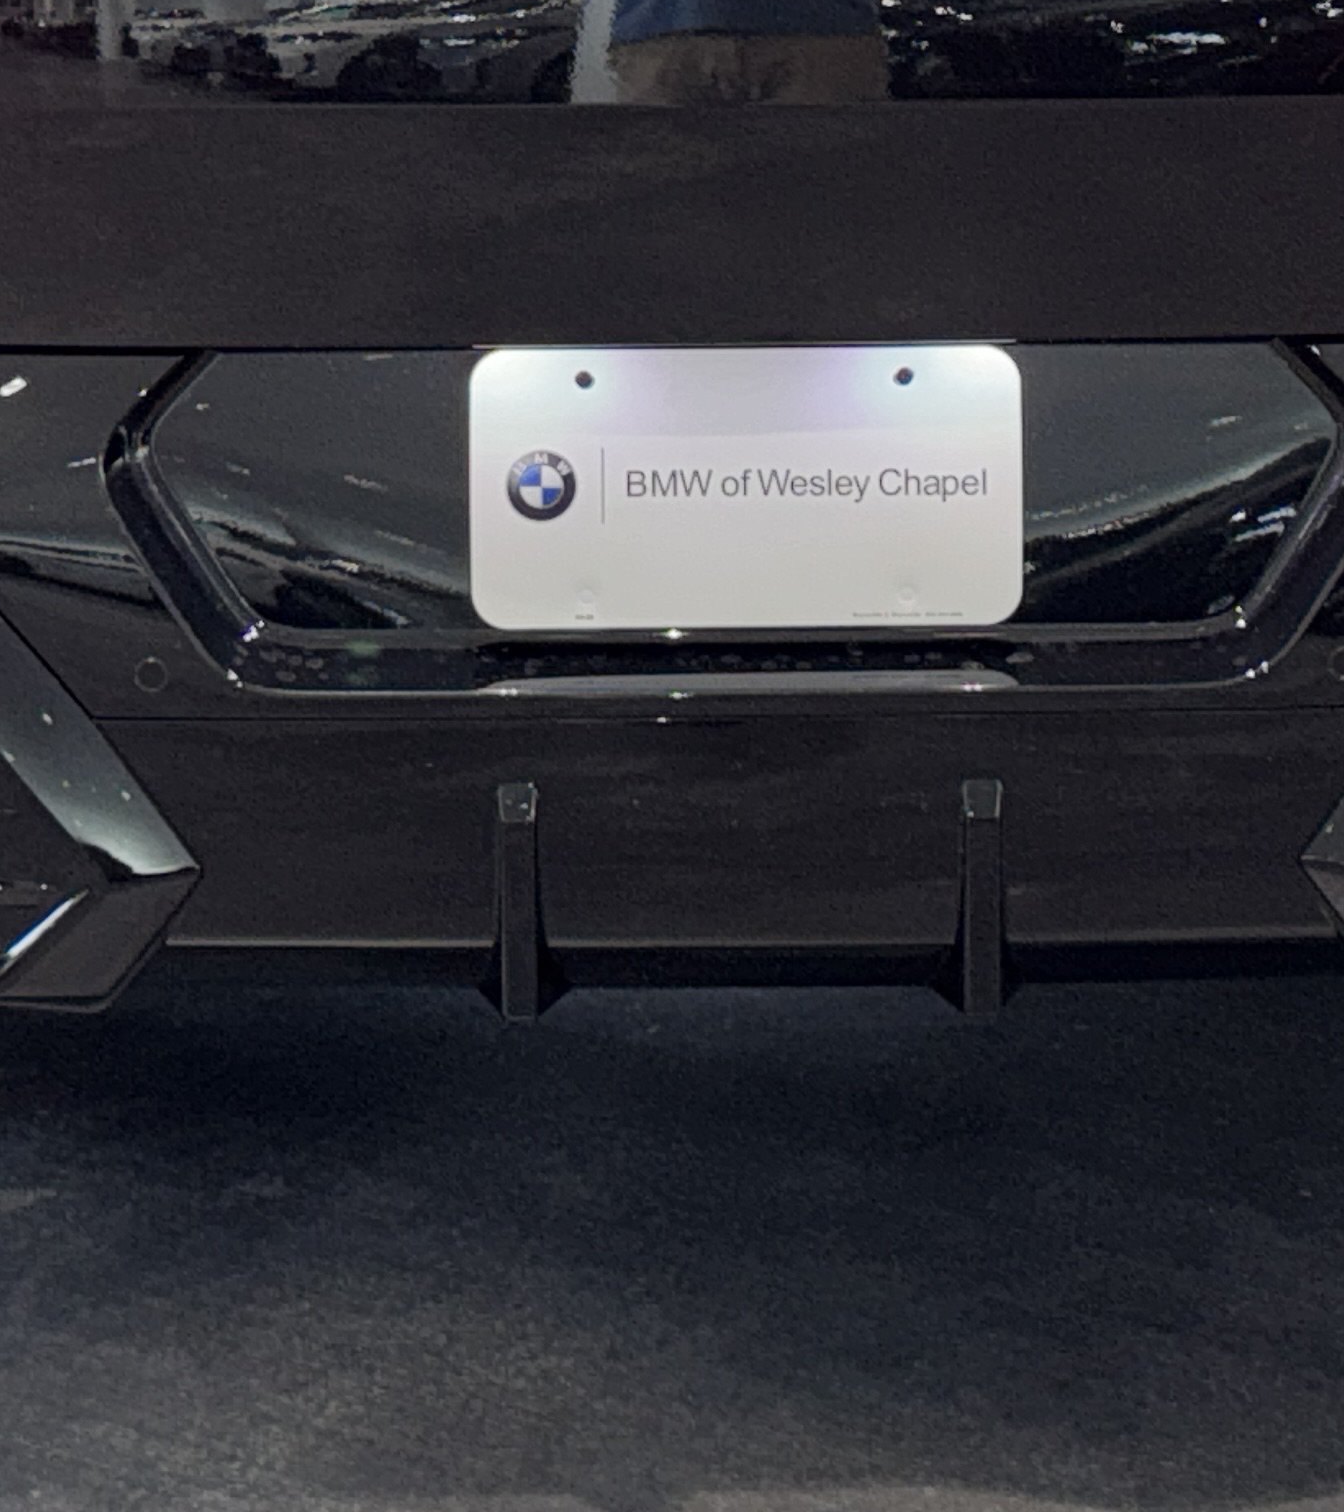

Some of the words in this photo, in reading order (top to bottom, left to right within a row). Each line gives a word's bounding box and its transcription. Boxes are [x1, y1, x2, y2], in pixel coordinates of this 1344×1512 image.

[625, 469, 714, 498] BMW
[720, 468, 753, 497] of
[756, 468, 871, 503] Wesley
[878, 467, 988, 502] Chapel
